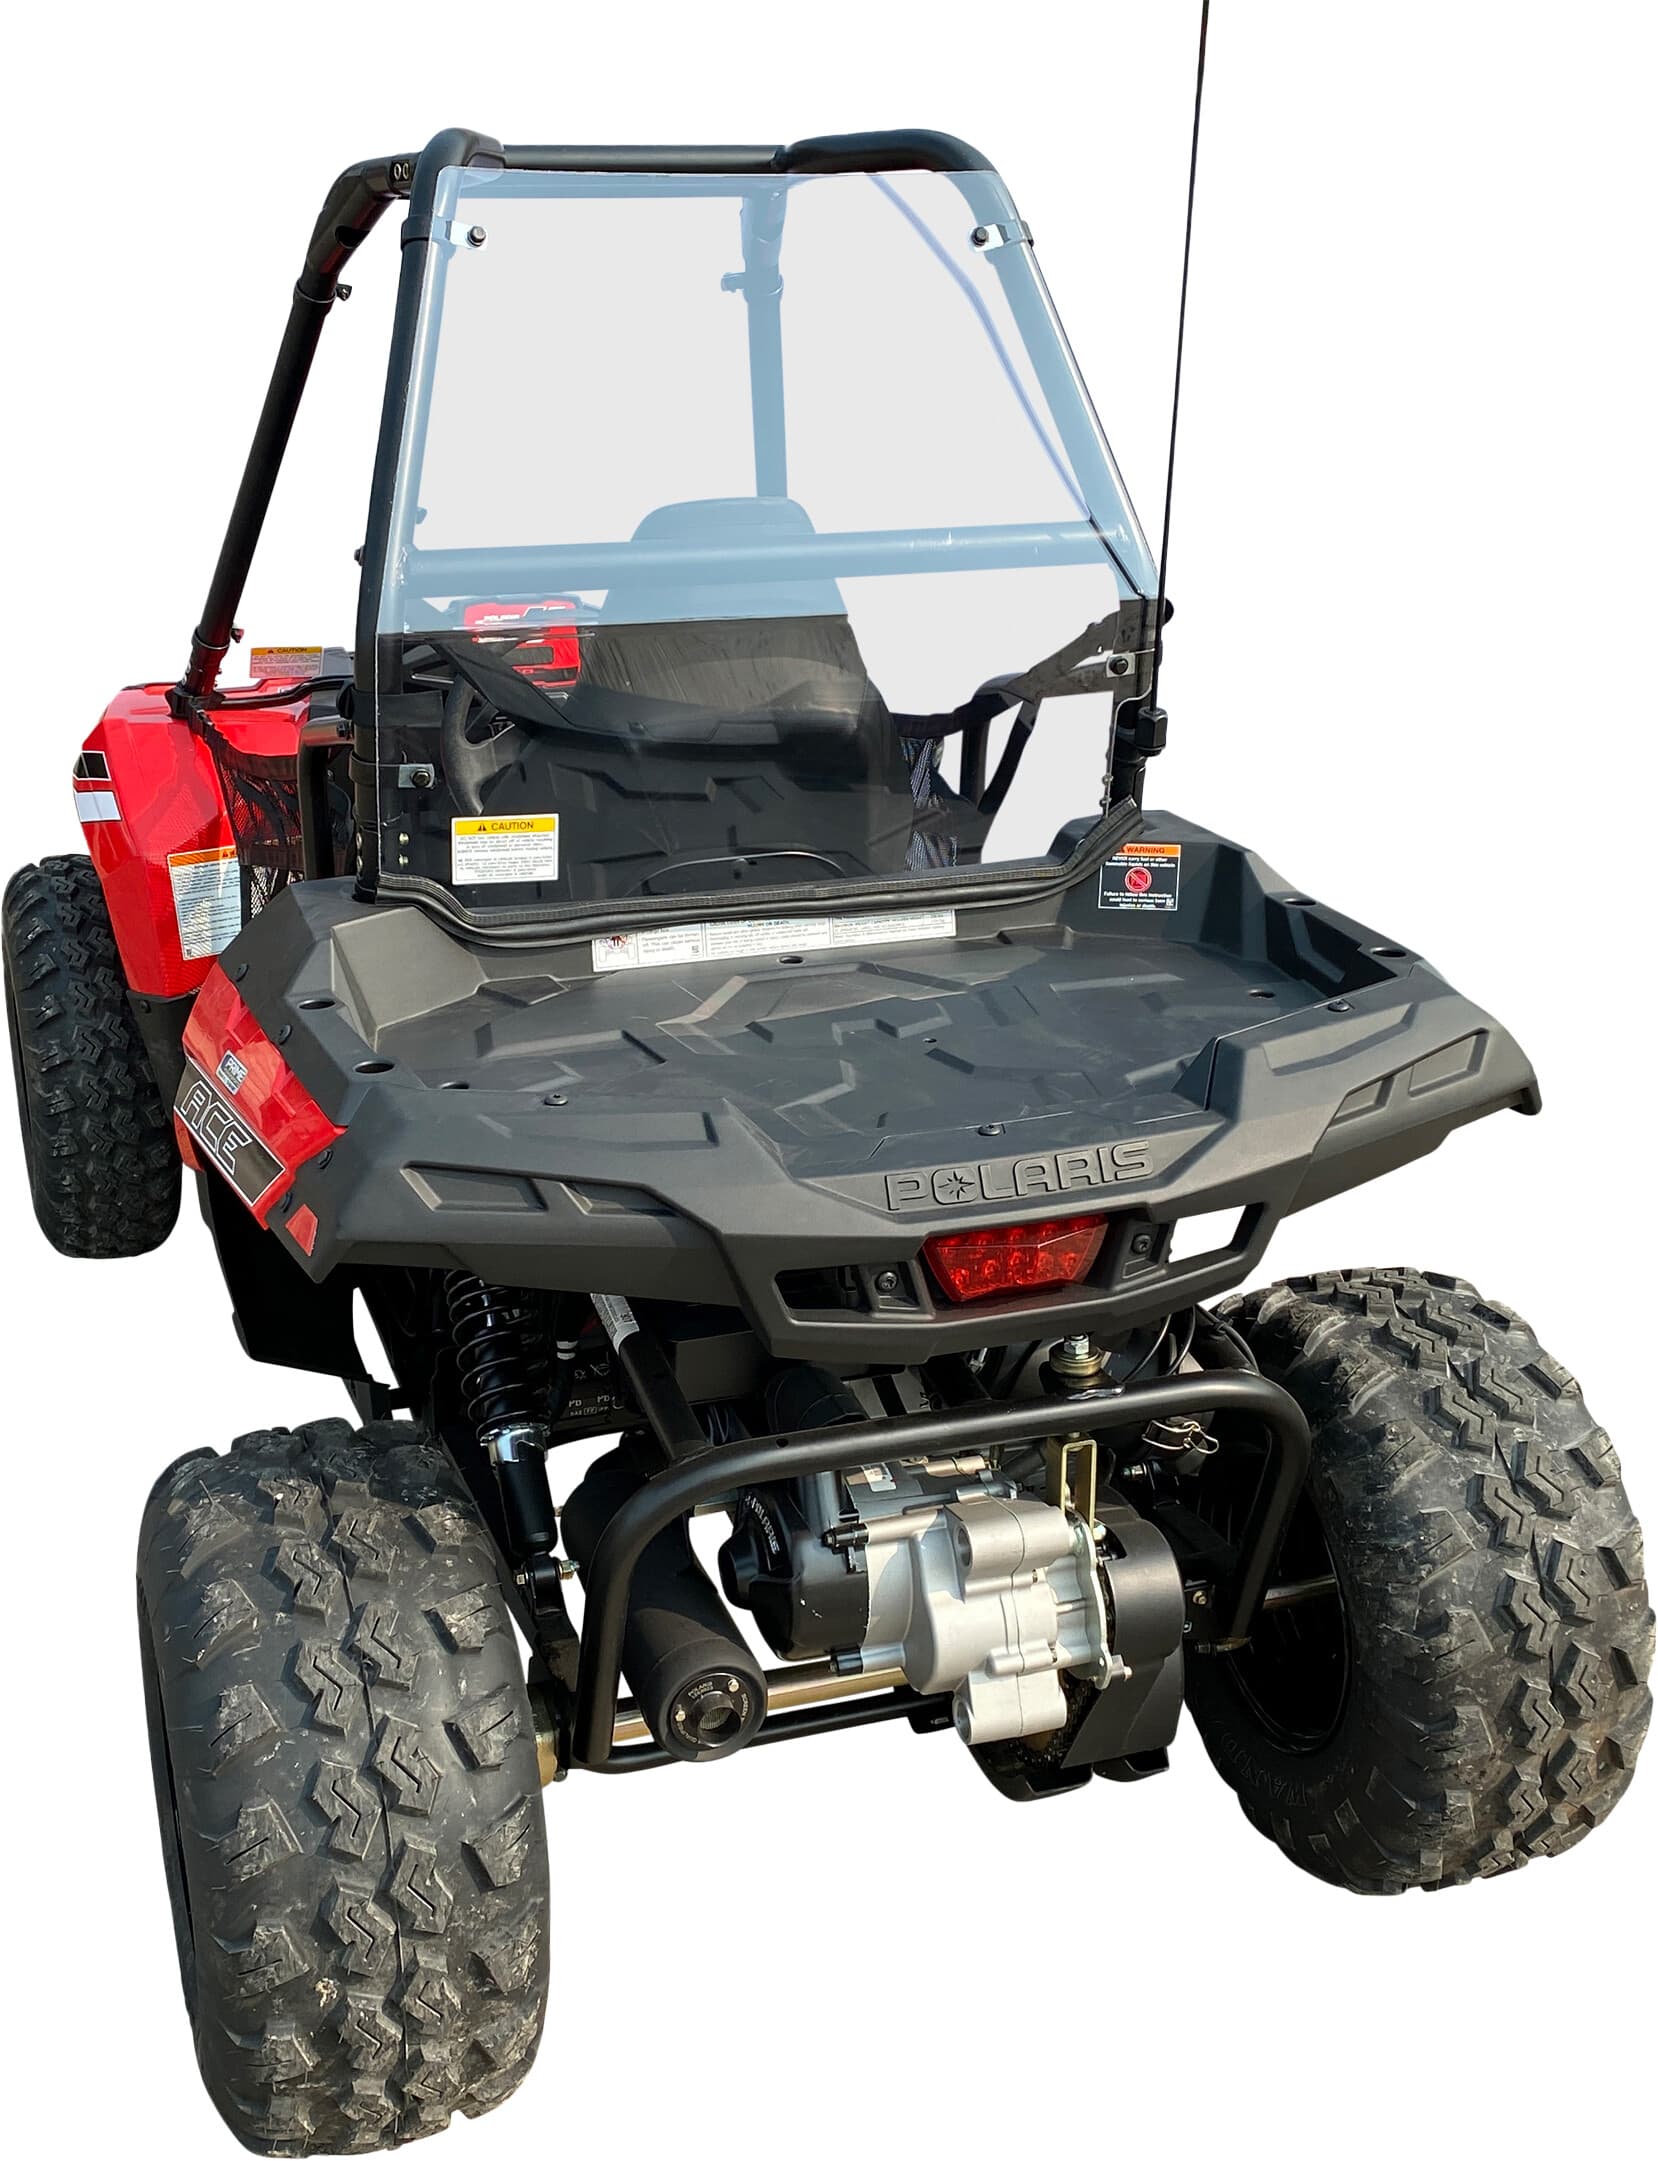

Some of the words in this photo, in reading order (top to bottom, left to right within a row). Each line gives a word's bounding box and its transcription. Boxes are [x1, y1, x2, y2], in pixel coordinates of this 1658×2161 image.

[491, 821, 534, 831] CAUTION
[1126, 846, 1165, 854] WARNING
[181, 1080, 253, 1176] ACE
[885, 1140, 1155, 1210] POLARIS
